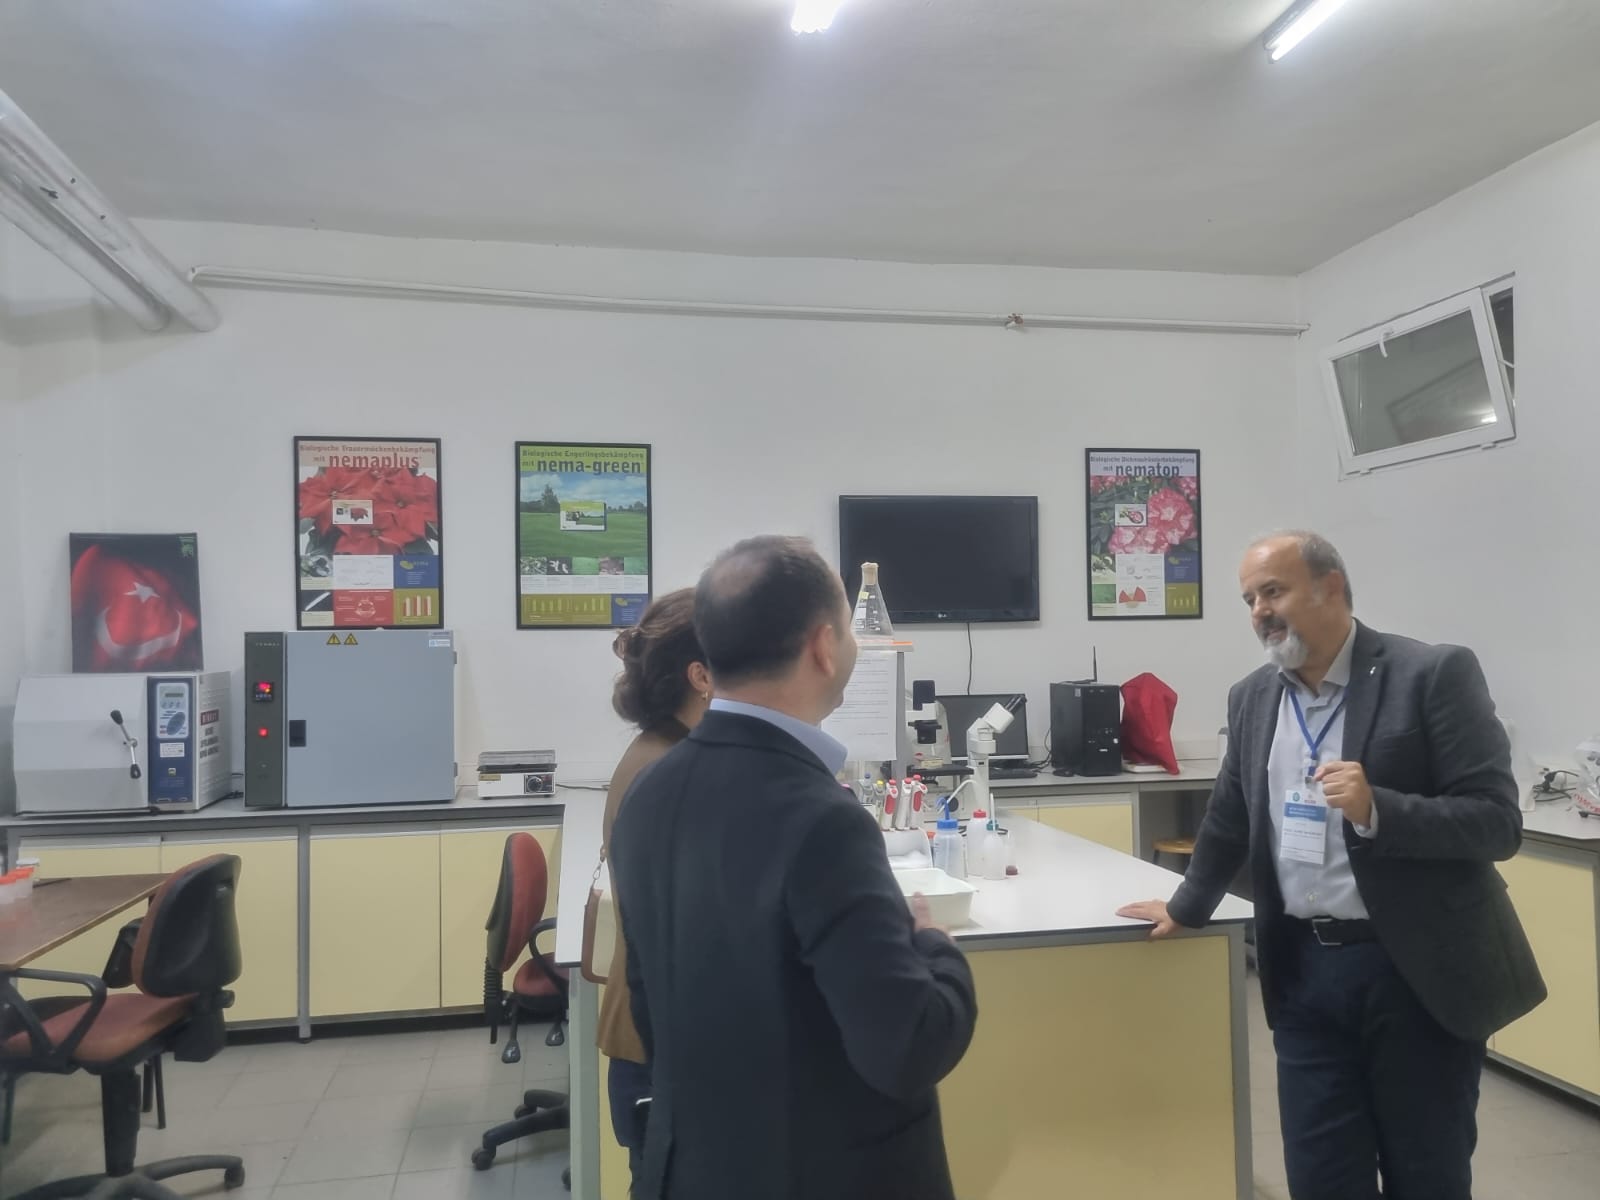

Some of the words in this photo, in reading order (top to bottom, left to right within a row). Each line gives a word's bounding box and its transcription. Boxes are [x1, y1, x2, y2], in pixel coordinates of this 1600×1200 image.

[329, 453, 419, 468] nemaplus
[537, 460, 641, 476] nema-green
[1116, 462, 1180, 477] nematop
